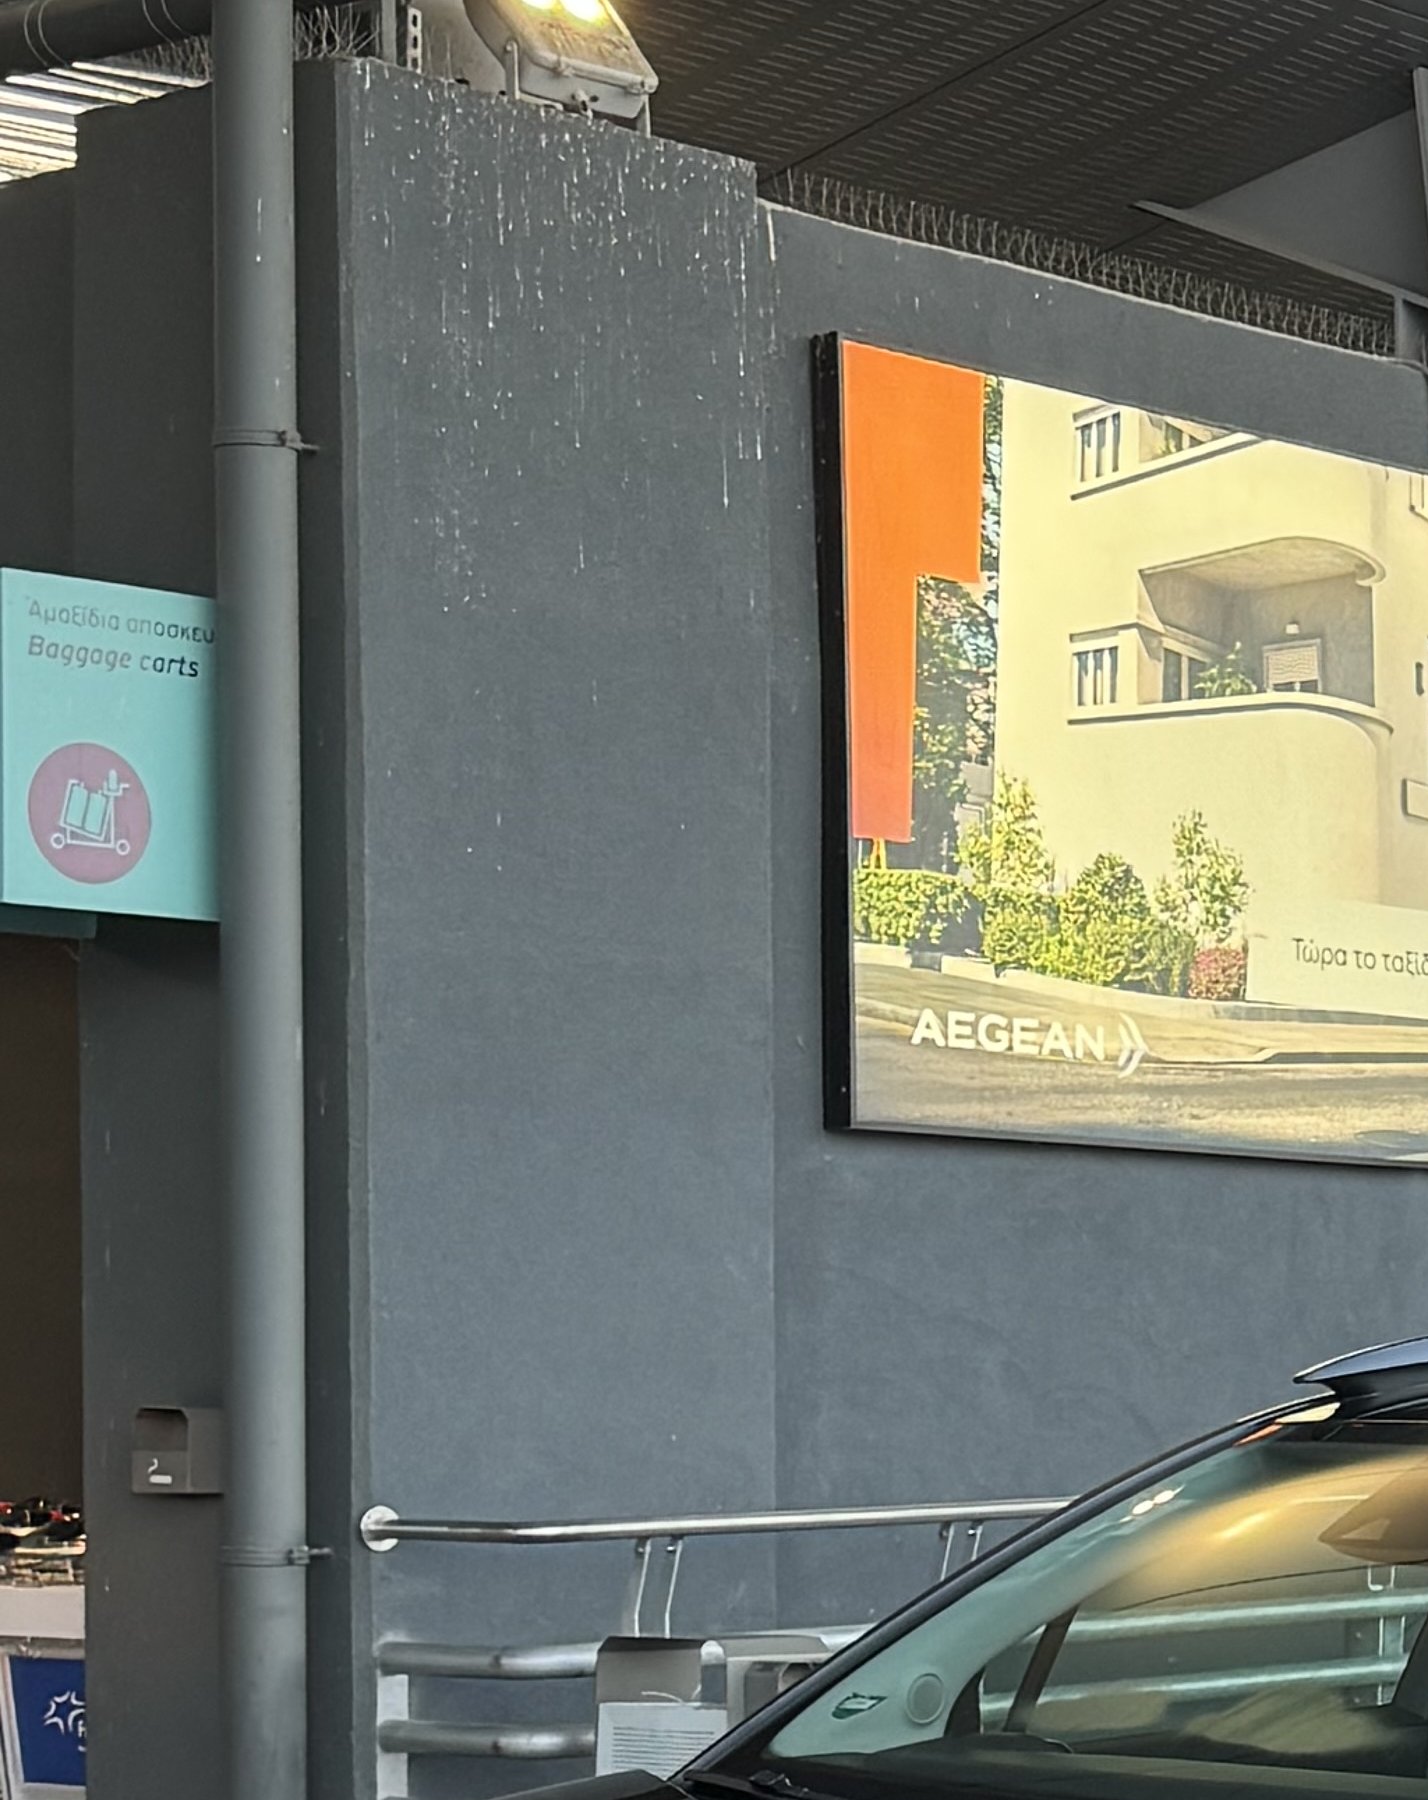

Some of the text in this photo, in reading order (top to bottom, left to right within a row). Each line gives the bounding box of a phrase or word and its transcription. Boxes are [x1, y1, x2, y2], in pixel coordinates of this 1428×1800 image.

[127, 618, 215, 644] αποσκευ
[28, 635, 199, 677] Baggage carts
[1292, 937, 1347, 971] Τώρα
[1353, 950, 1376, 970] το
[911, 1007, 1105, 1062] AEGEAN
